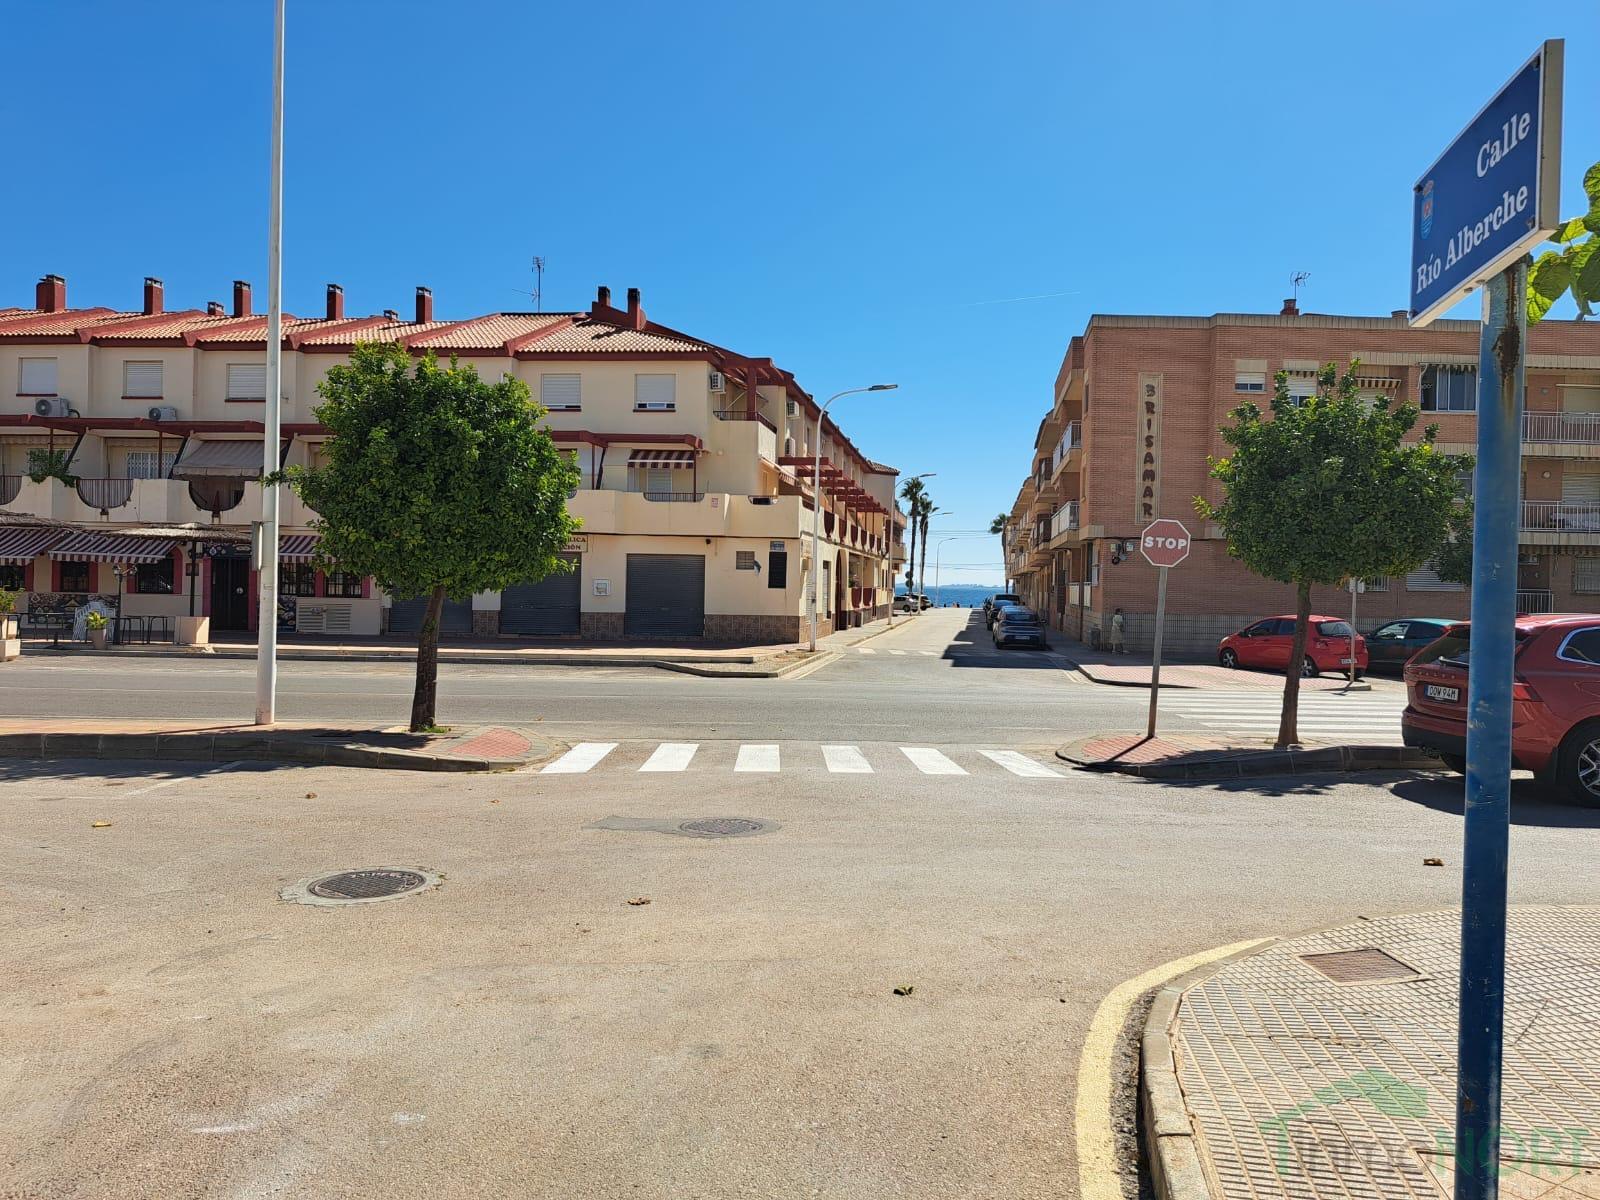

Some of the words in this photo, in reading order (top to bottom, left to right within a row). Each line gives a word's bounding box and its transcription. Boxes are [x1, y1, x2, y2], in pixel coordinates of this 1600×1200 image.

[1476, 111, 1531, 178] Calle
[1416, 253, 1442, 295] Río
[1444, 185, 1528, 271] Alberche
[1142, 384, 1156, 516] BRISAMAR
[1144, 536, 1187, 550] STOP
